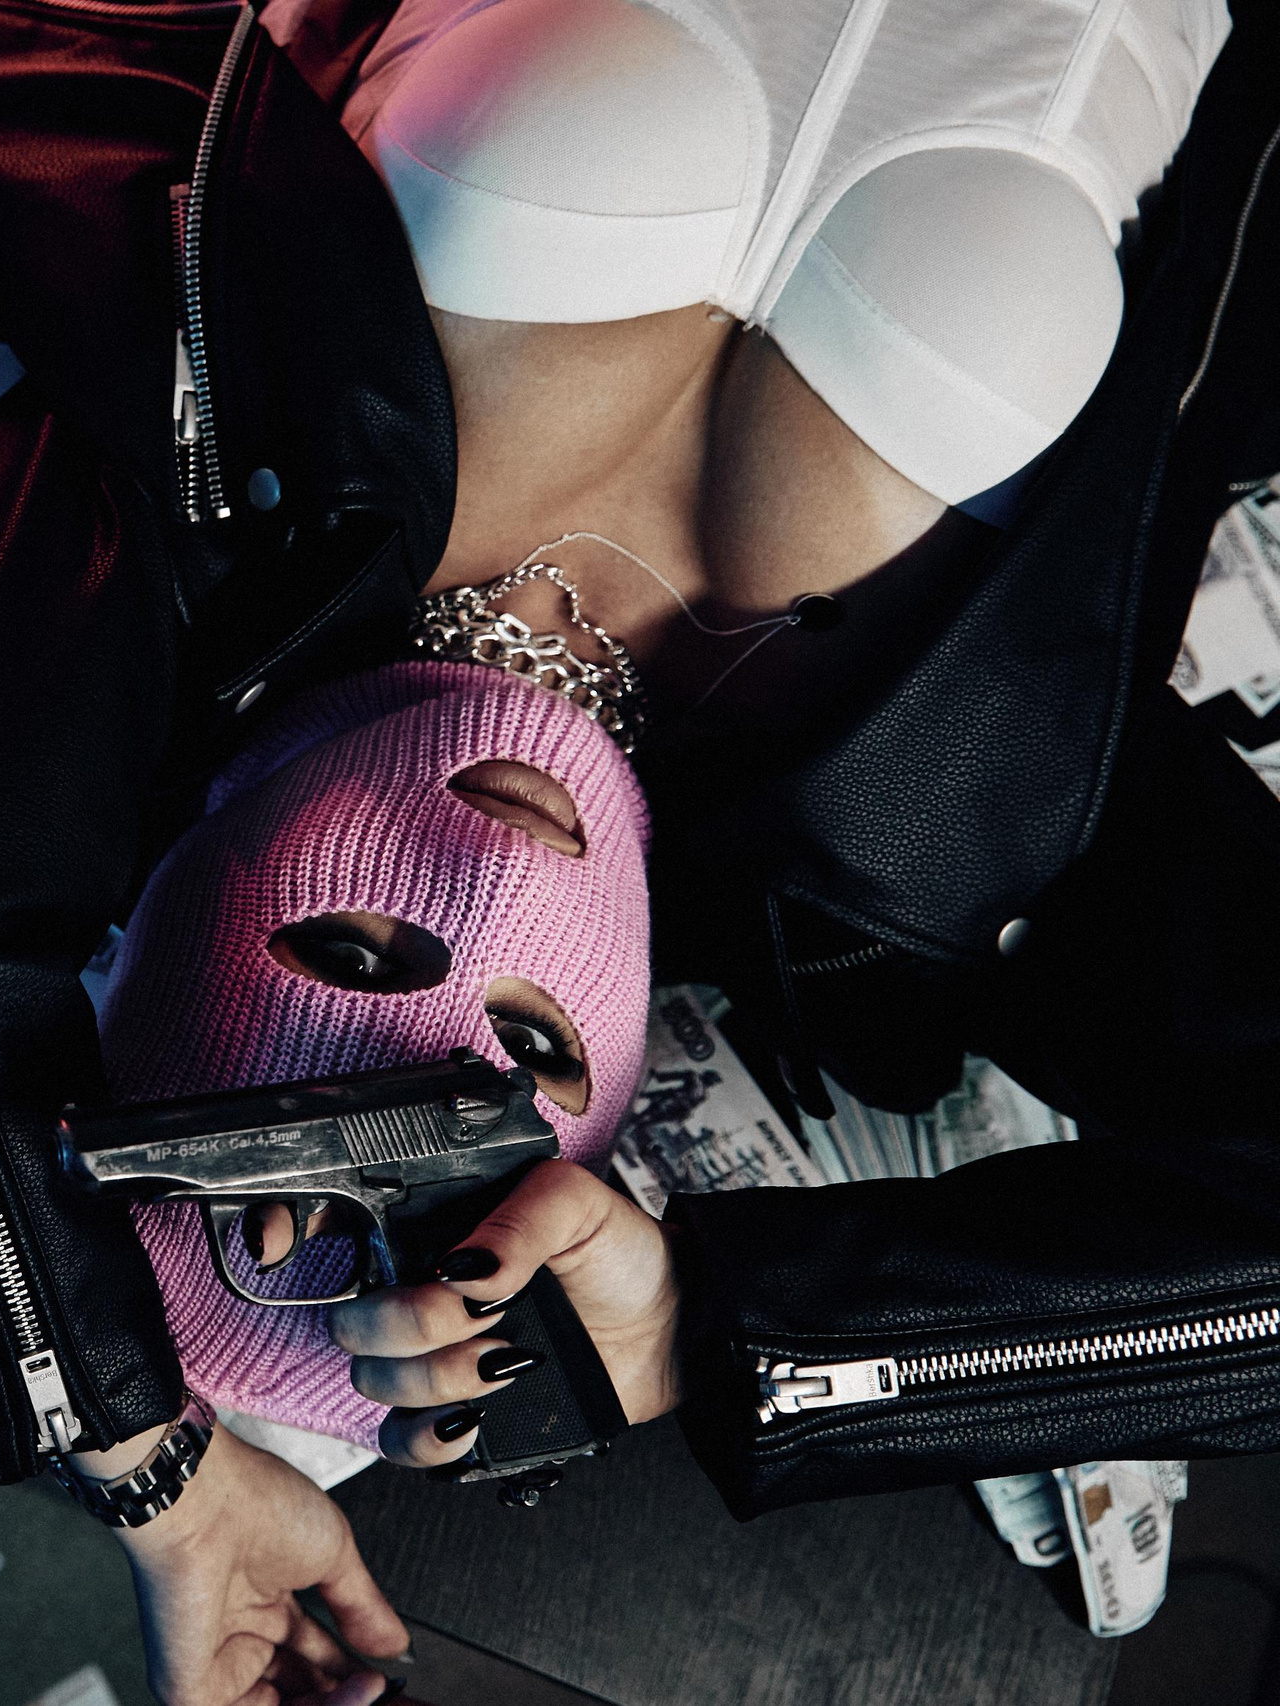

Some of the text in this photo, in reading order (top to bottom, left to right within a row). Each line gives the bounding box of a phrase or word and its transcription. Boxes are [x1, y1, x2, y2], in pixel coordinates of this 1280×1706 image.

[147, 1139, 220, 1163] MP-654K
[27, 1370, 58, 1385] Bershka
[866, 1363, 878, 1398] Bershka
